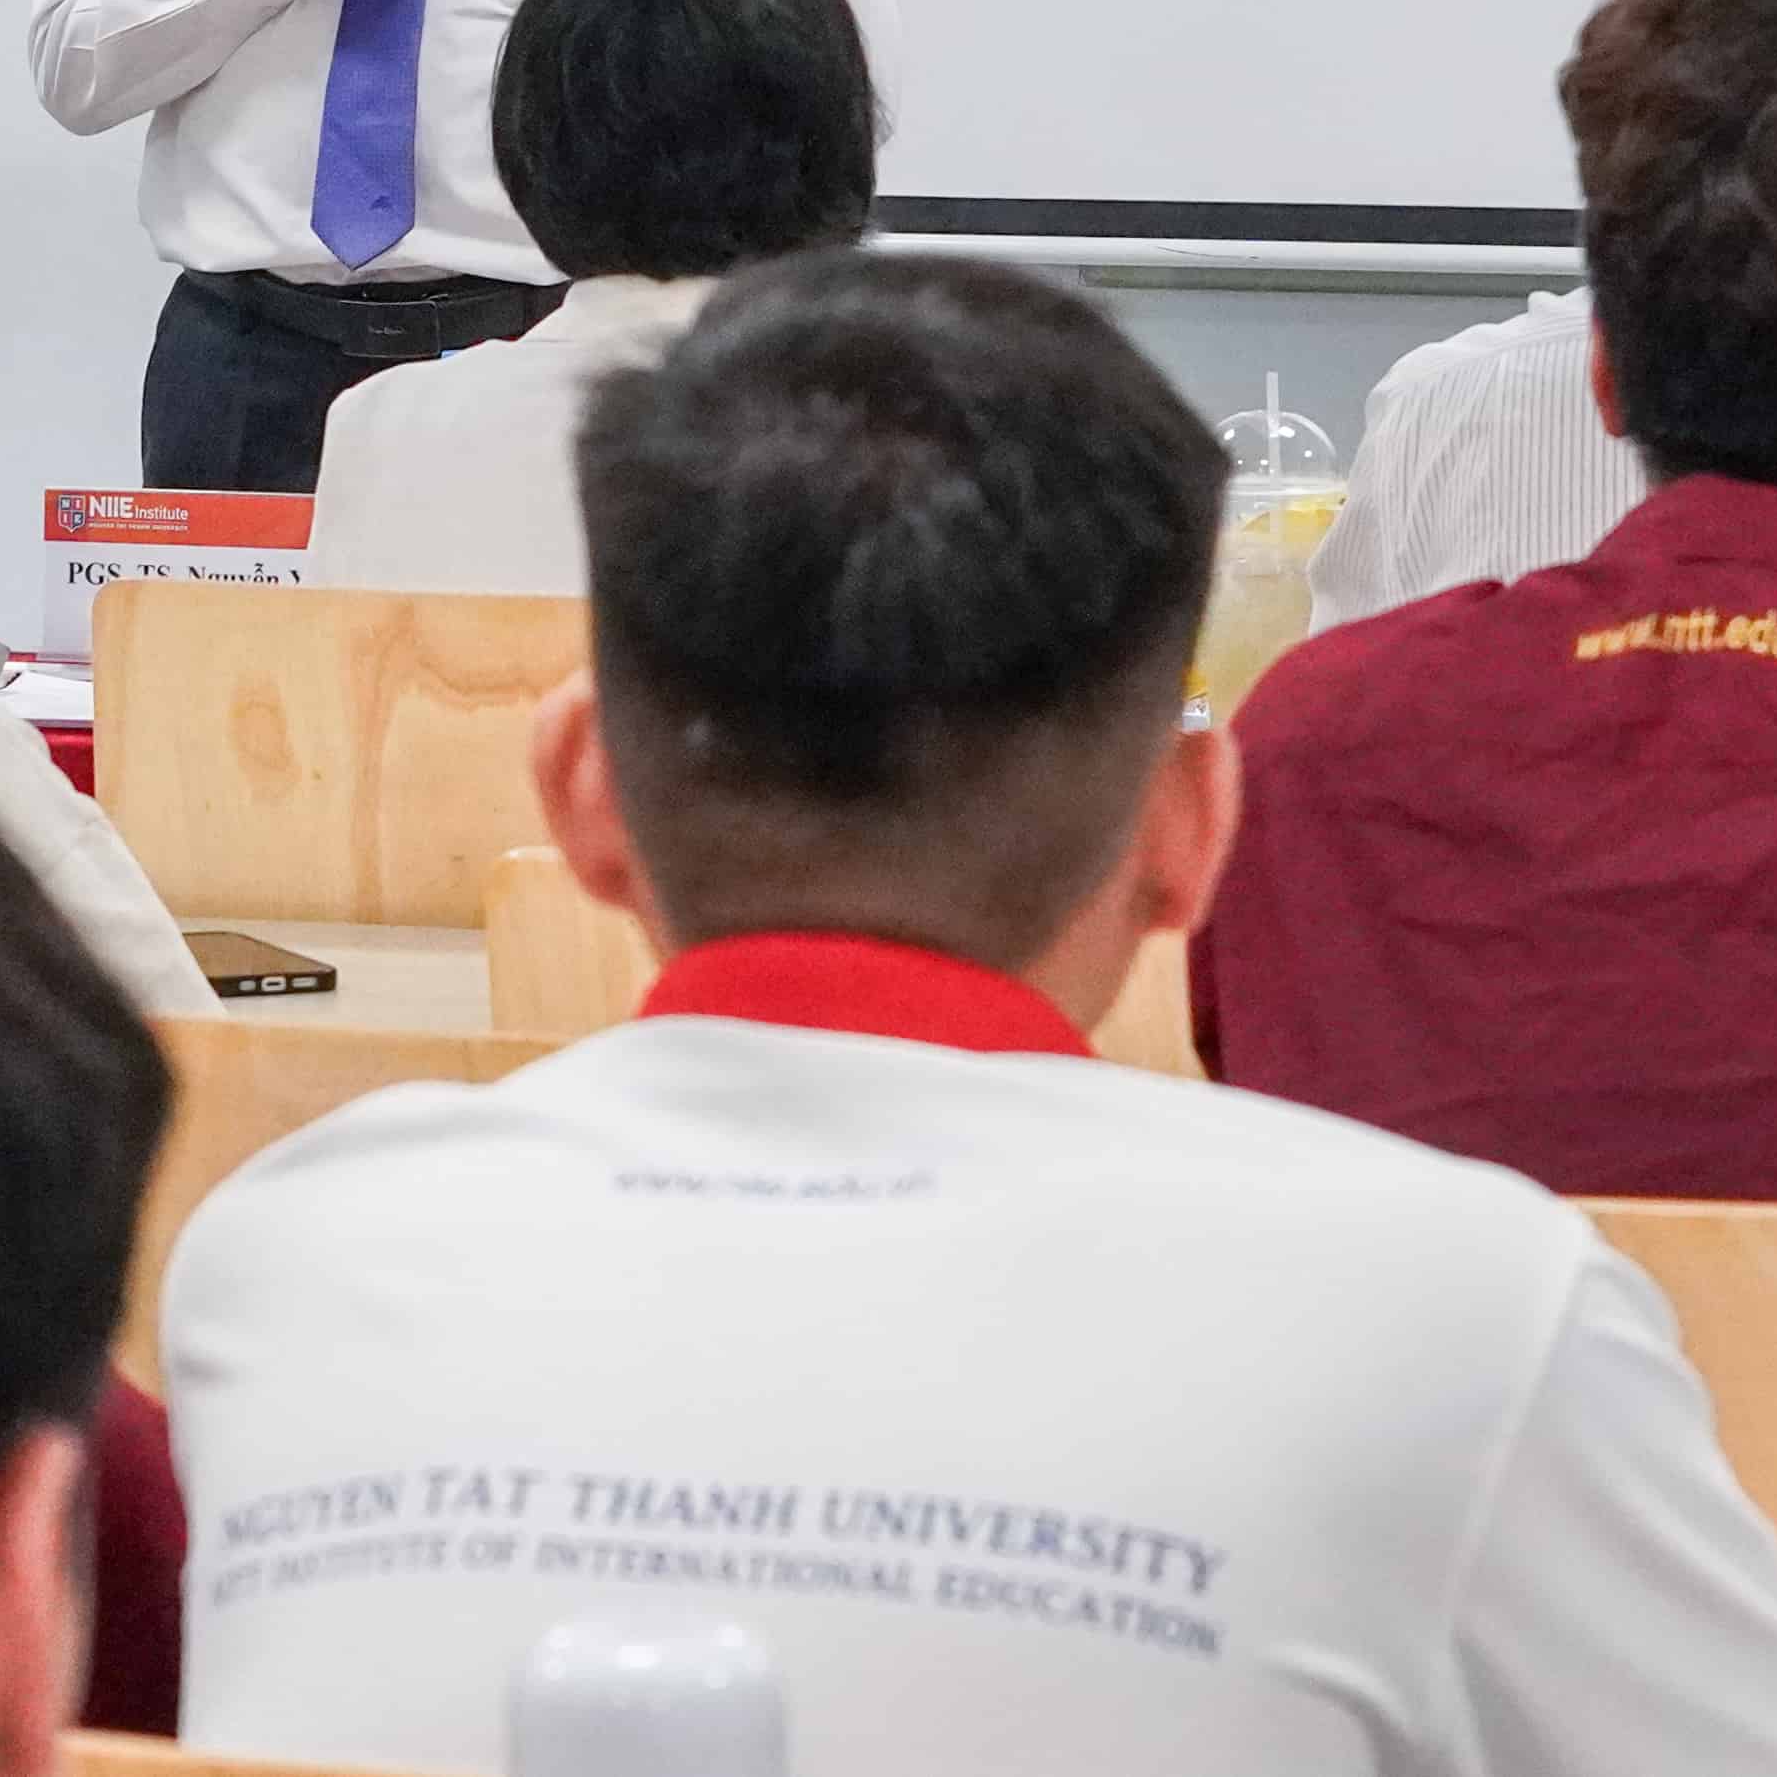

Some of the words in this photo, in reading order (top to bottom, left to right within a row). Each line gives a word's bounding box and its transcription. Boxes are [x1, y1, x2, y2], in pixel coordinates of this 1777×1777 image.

[89, 495, 134, 519] NIIE
[134, 505, 189, 521] Institute
[425, 1464, 548, 1519] TAT
[570, 1471, 799, 1535] THANH
[822, 1487, 1228, 1596] UNIVERSITY
[533, 1531, 917, 1604] INTERNATIONAL
[935, 1560, 1223, 1657] EDUCATION
